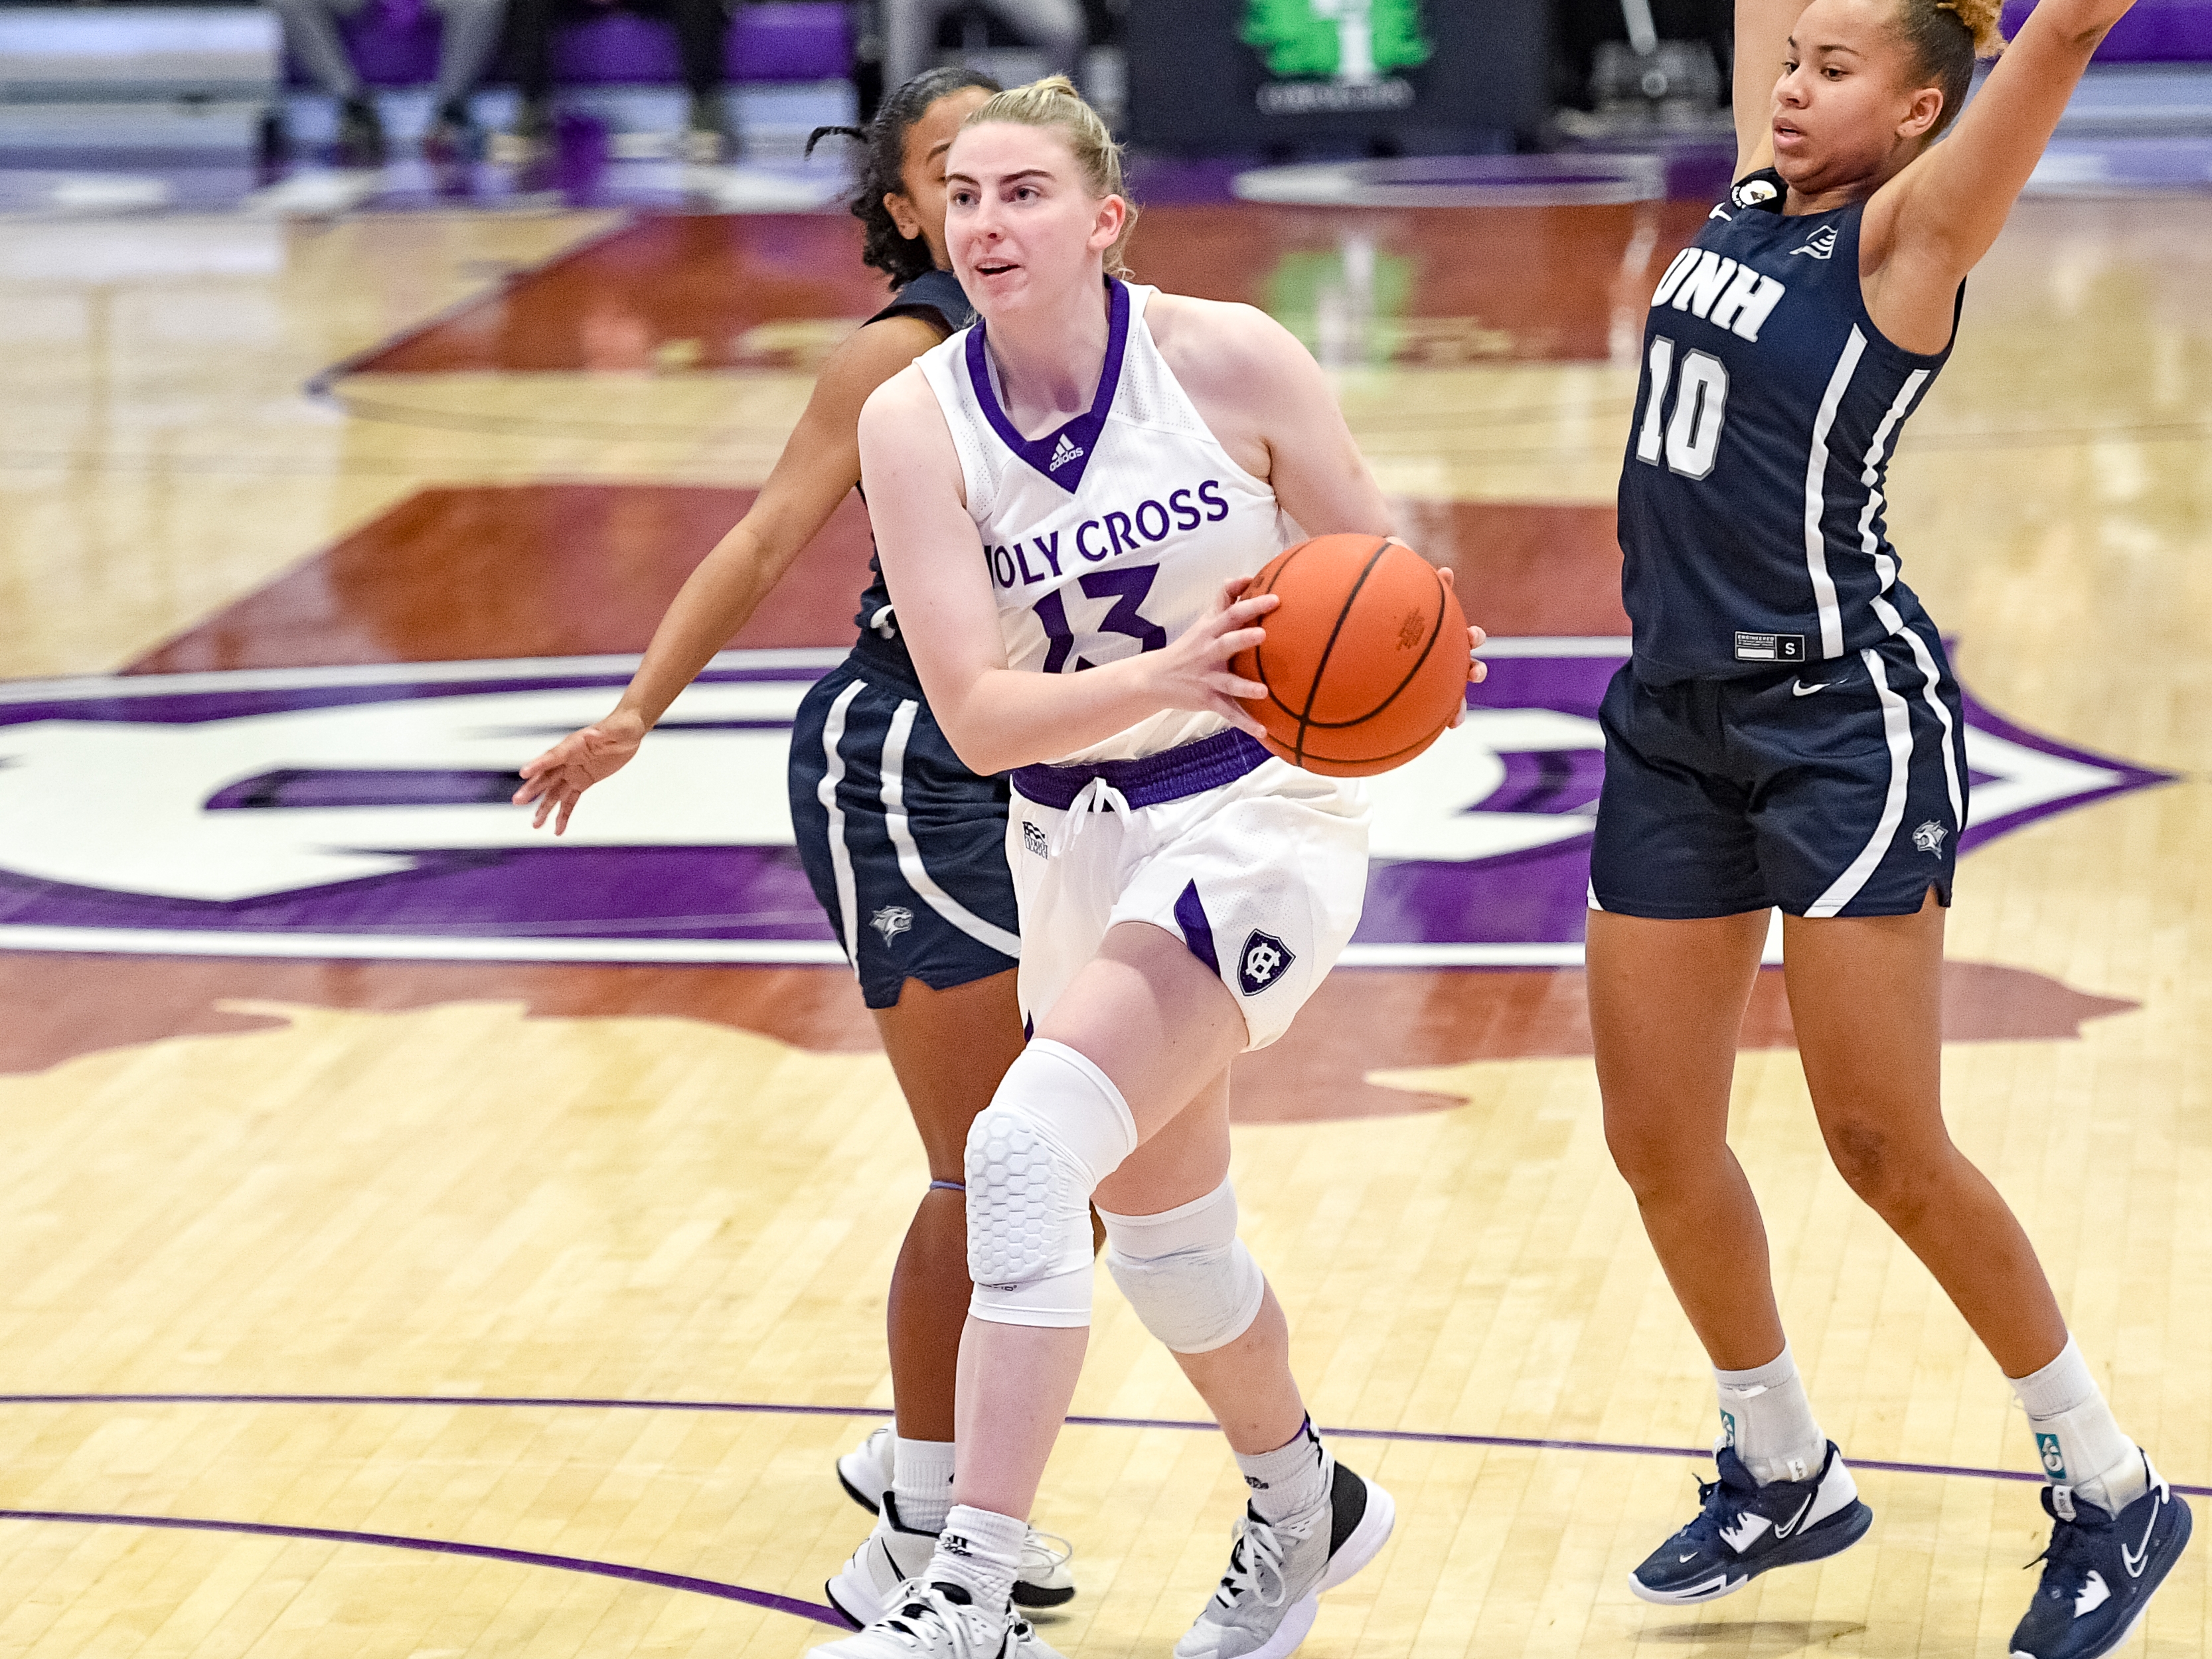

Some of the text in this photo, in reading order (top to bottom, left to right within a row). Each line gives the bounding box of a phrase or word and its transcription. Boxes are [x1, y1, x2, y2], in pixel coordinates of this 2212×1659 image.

[1650, 246, 1786, 343] UNH
[1635, 334, 1730, 481] 10
[1049, 446, 1084, 473] adidas
[1075, 479, 1229, 562] CROSS
[1032, 562, 1168, 674] 13
[1784, 642, 1796, 655] S
